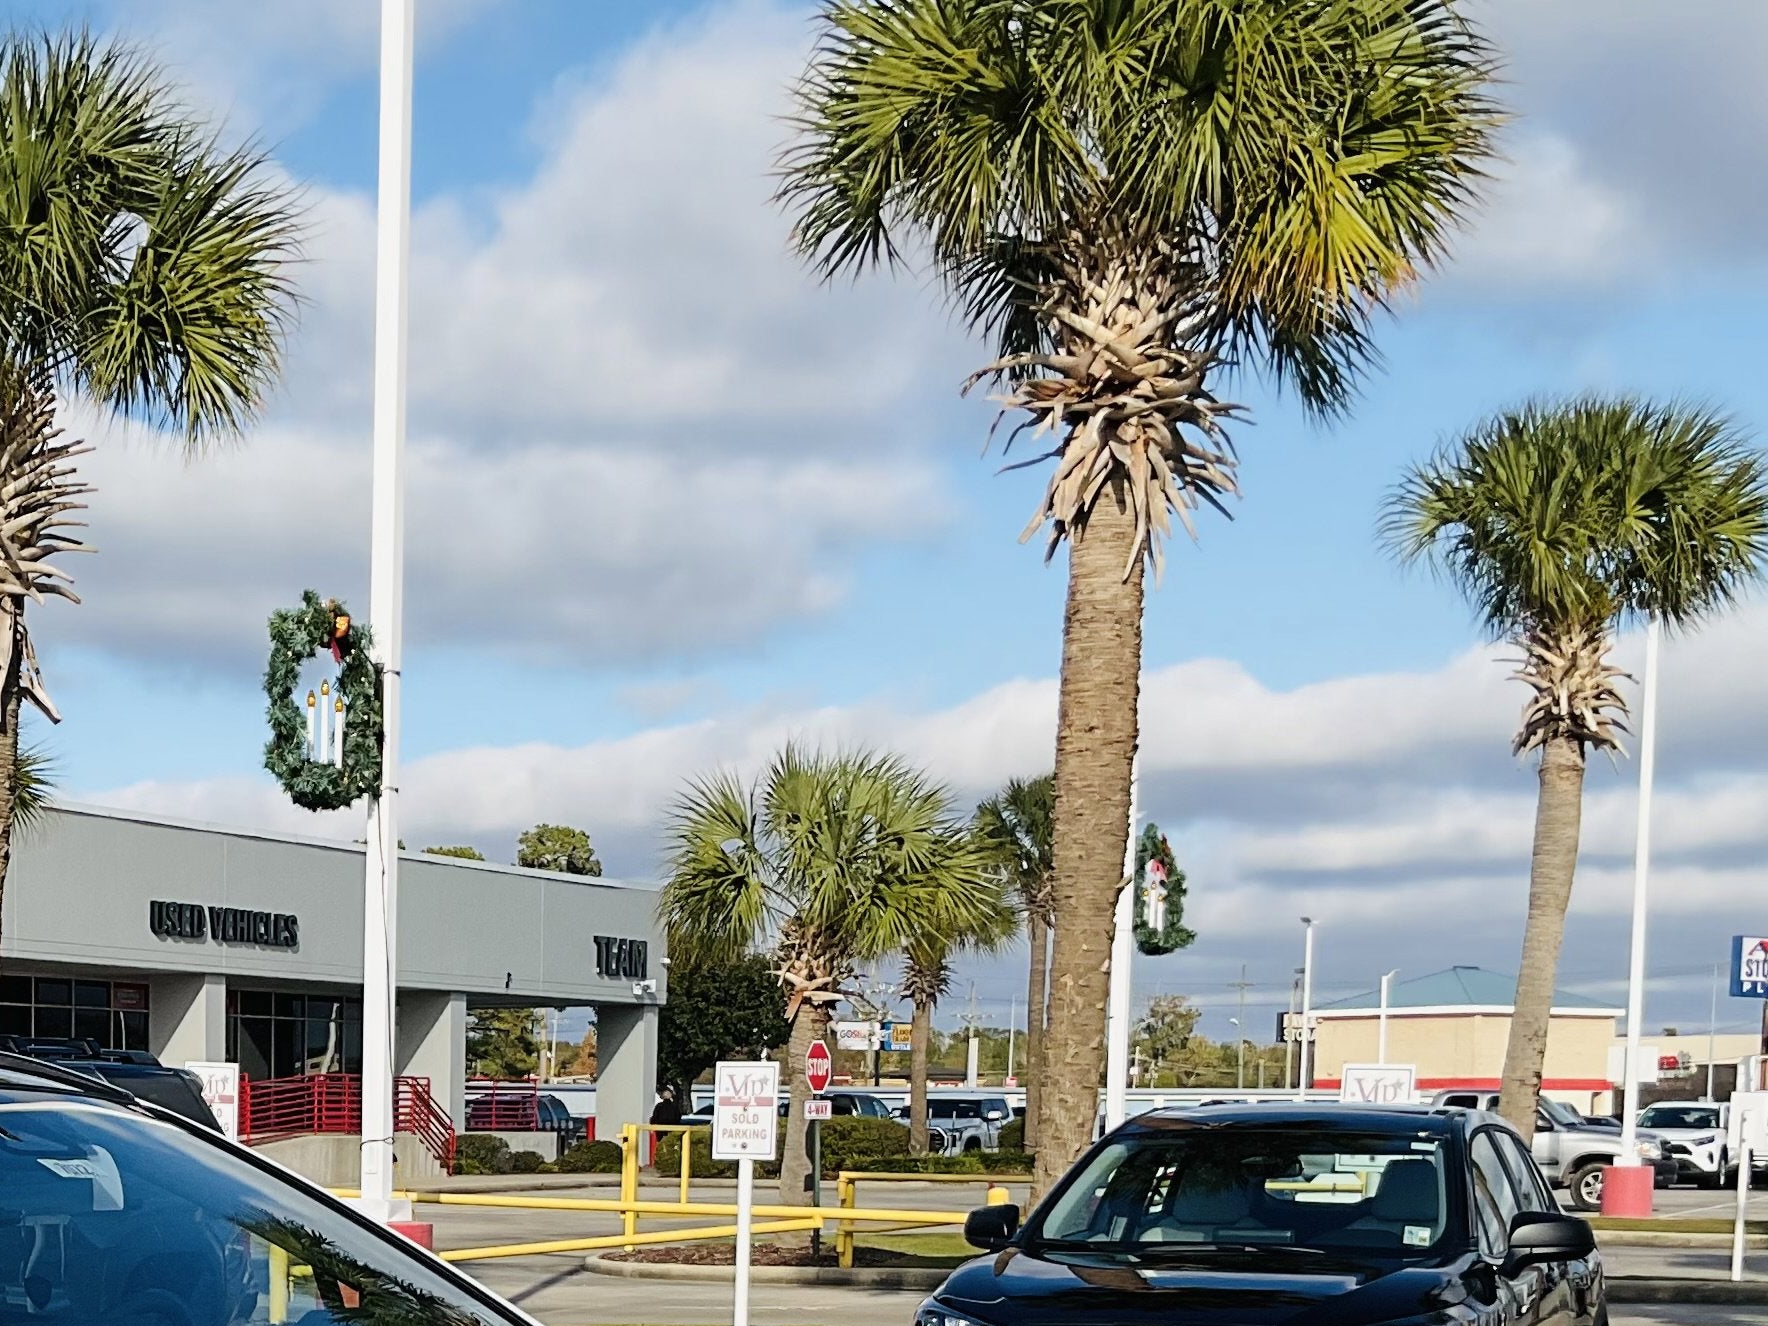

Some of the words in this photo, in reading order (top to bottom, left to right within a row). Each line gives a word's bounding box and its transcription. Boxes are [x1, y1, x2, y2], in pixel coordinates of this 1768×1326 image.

[150, 900, 206, 938] USED
[208, 906, 298, 947] VEHICLES
[593, 935, 648, 978] TEAM
[808, 1058, 829, 1076] STOP
[807, 1104, 828, 1115] 4-WAY
[731, 1113, 759, 1125] SOLD
[721, 1128, 768, 1140] PARKING
